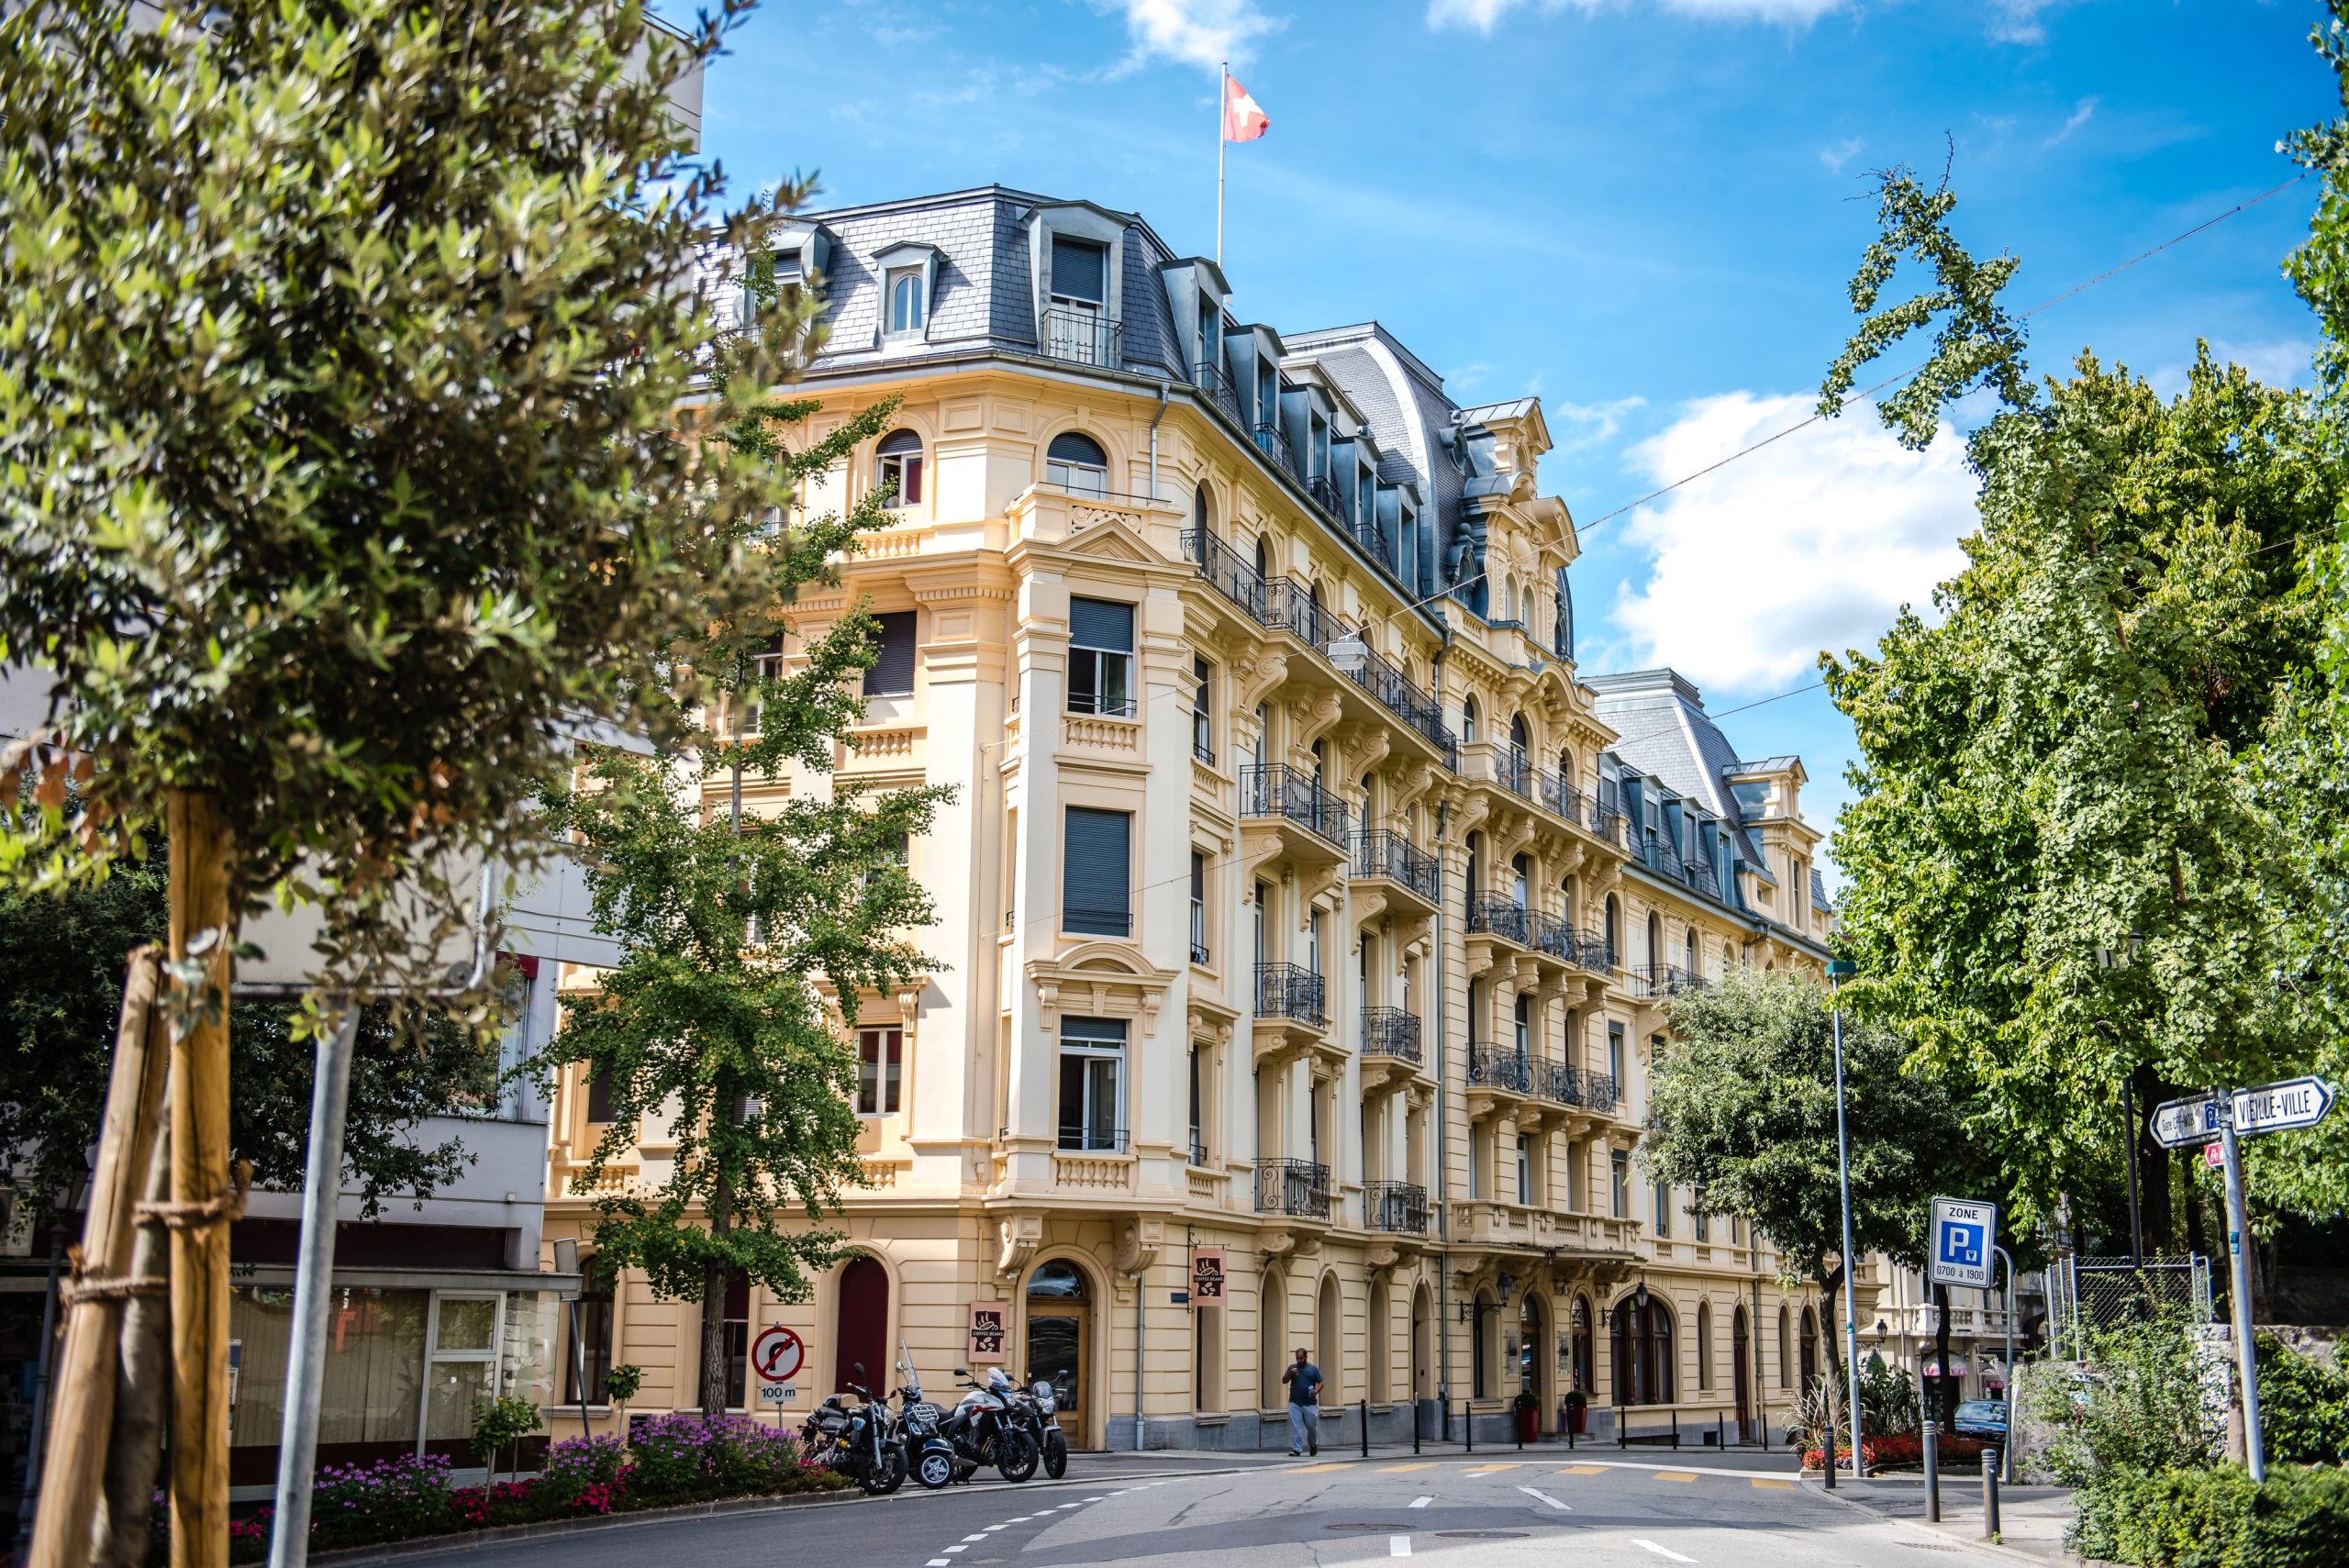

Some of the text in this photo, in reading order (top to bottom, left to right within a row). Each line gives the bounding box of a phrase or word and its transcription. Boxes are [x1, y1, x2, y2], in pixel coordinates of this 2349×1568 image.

[2239, 1090, 2311, 1123] VIEILLE-VILLE
[2208, 1110, 2213, 1127] P
[1949, 1207, 1979, 1219] ZONE
[1948, 1227, 1970, 1257] P
[1936, 1265, 1984, 1281] 0700 à 1900
[762, 1387, 796, 1397] 100 m
